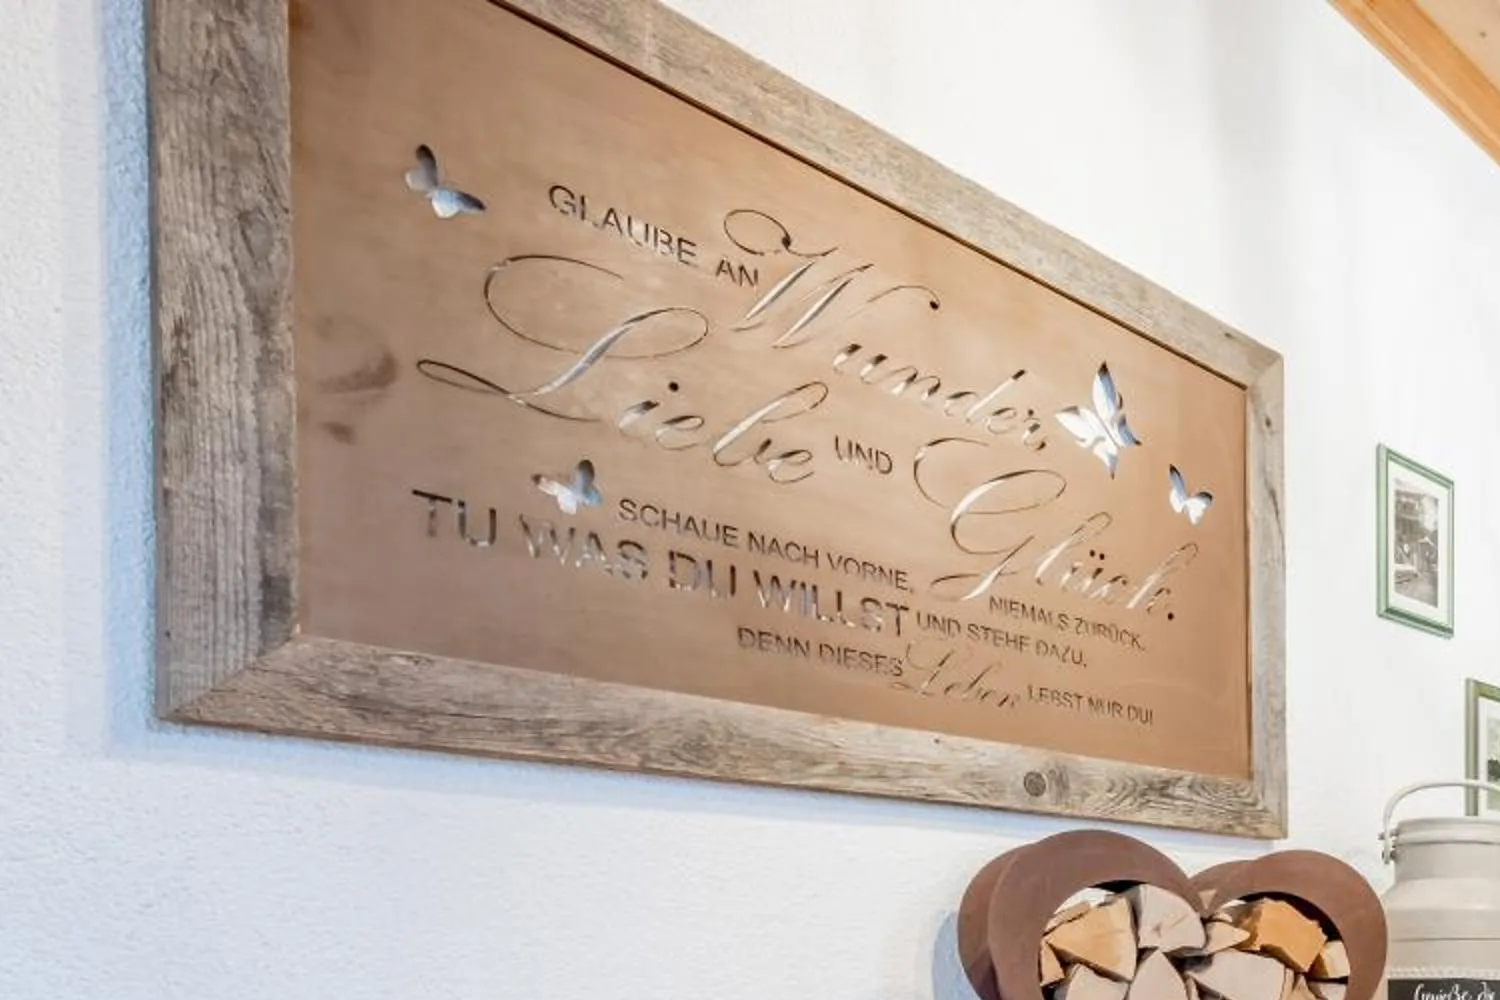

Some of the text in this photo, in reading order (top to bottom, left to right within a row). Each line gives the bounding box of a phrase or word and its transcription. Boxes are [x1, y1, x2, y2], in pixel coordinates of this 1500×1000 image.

[549, 185, 698, 264] GLAUBE
[715, 259, 760, 289] AN
[416, 254, 829, 485] Liebe
[834, 435, 894, 477] UND
[412, 488, 1088, 669] TU WAS DU WILLST UND STEHE DAZU.
[618, 497, 740, 548] SCHAUE
[747, 530, 820, 569] NACH
[826, 552, 914, 594] VORNE,
[989, 595, 1070, 632] NIEMALS
[737, 625, 811, 659] DENN
[818, 642, 905, 678] DIESES
[1027, 684, 1084, 712] LEBST
[1087, 696, 1123, 720] NUR
[1127, 703, 1154, 726] DU!
